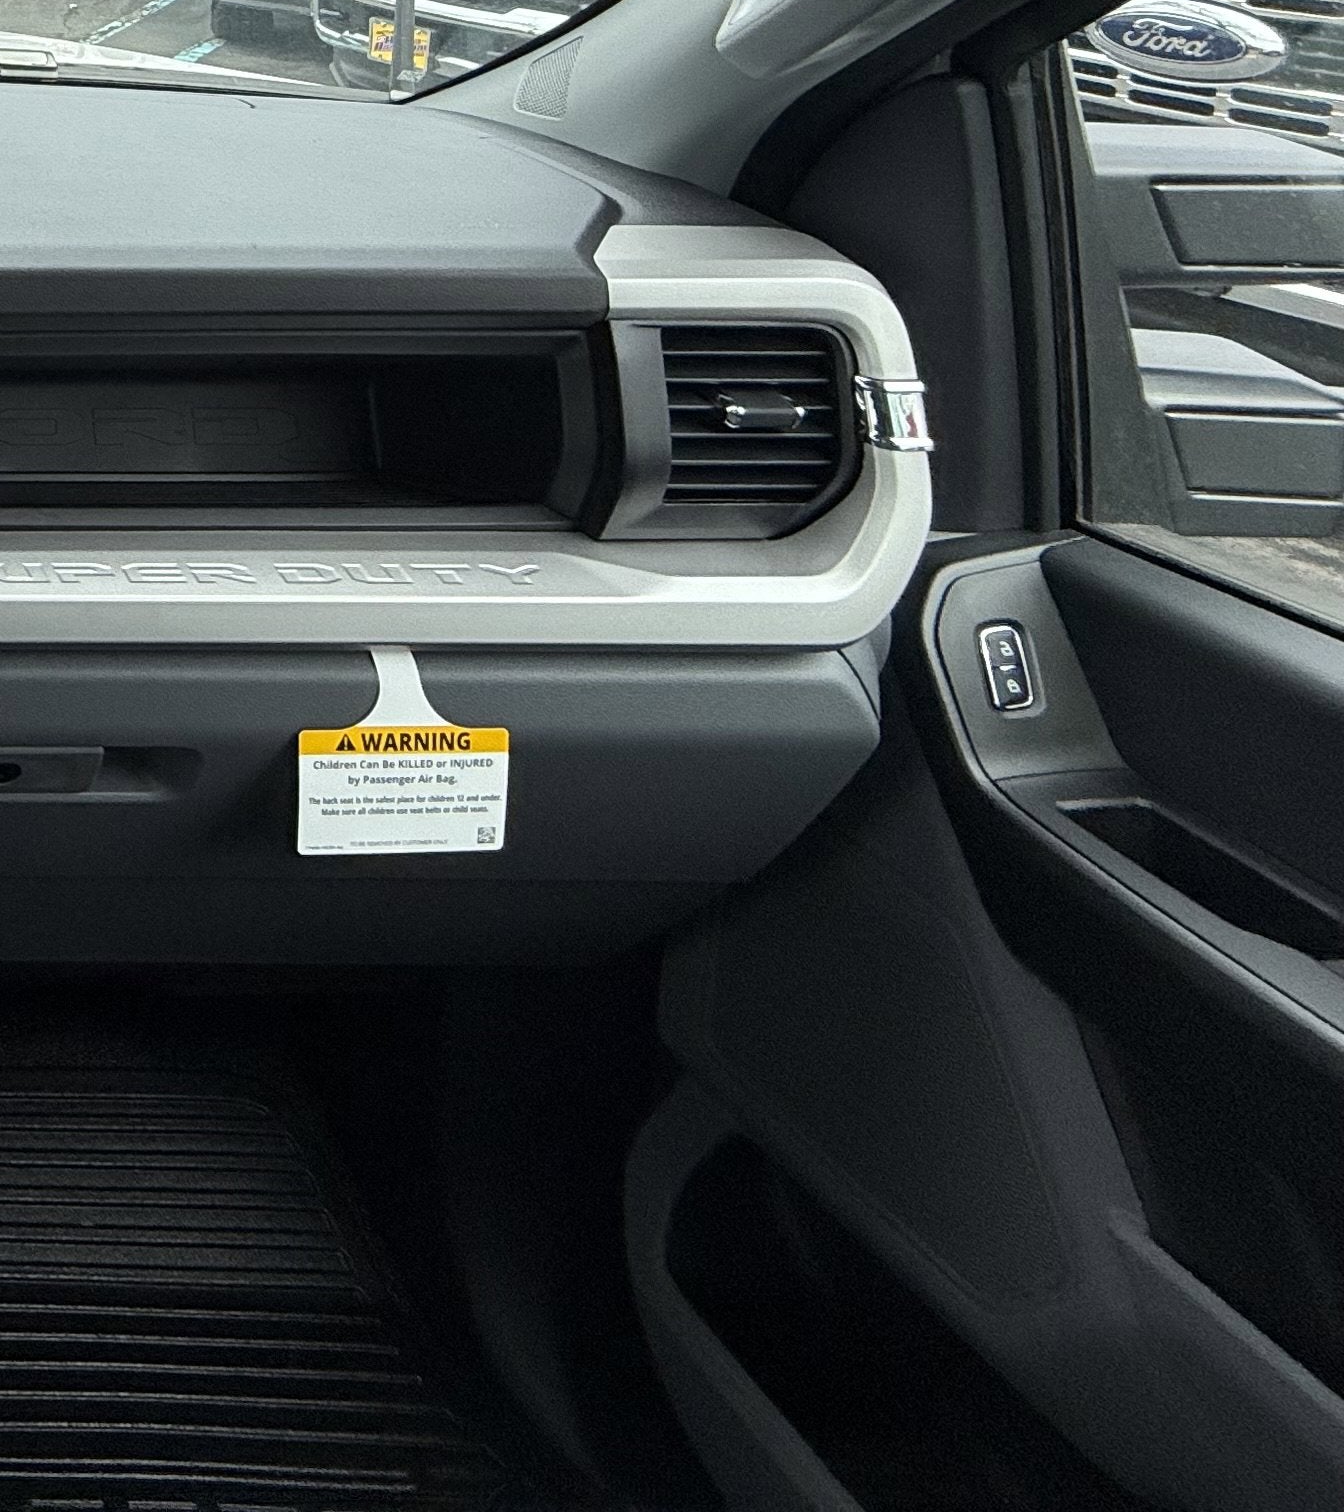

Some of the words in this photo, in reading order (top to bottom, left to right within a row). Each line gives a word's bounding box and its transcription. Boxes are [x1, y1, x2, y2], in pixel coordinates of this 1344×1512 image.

[1122, 18, 1213, 58] Ford
[272, 561, 541, 586] DUTY
[360, 731, 472, 752] WARNING
[312, 760, 358, 770] Children
[359, 760, 381, 770] Can
[382, 760, 395, 769] Be
[398, 759, 434, 769] KILLED
[435, 760, 448, 768] or
[449, 758, 494, 769] INJURED
[347, 775, 360, 787] by
[362, 775, 416, 786] Passenger
[418, 774, 434, 784] Air
[436, 774, 458, 785] Bag.
